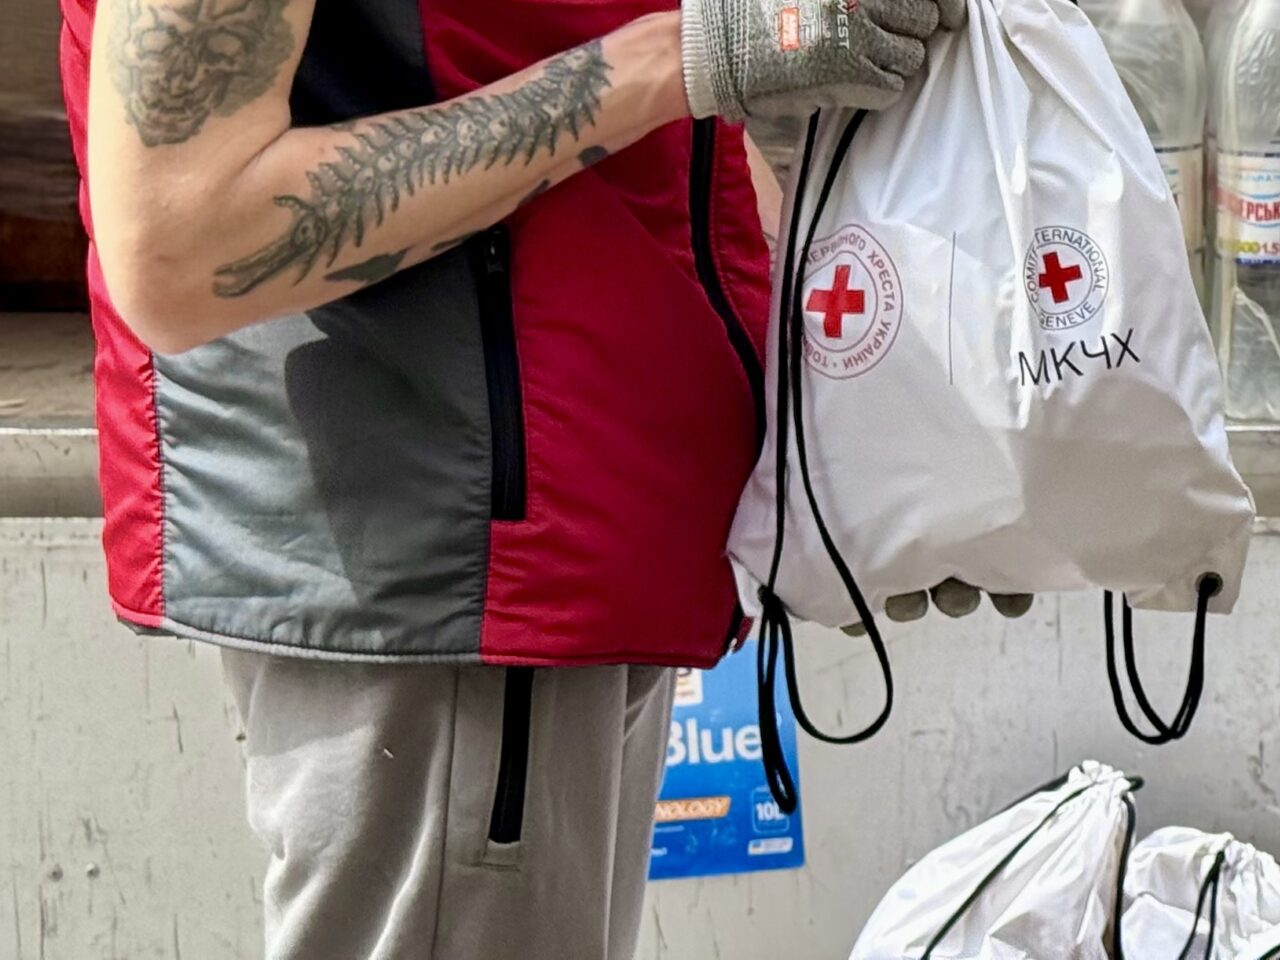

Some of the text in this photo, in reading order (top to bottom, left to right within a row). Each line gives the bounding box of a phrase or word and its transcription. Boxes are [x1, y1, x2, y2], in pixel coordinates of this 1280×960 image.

[867, 249, 895, 312] ХРЕСТА
[1034, 228, 1106, 292] TERNATIONAL
[1018, 328, 1141, 386] МКЧХ
[655, 799, 725, 819] NOLOGY
